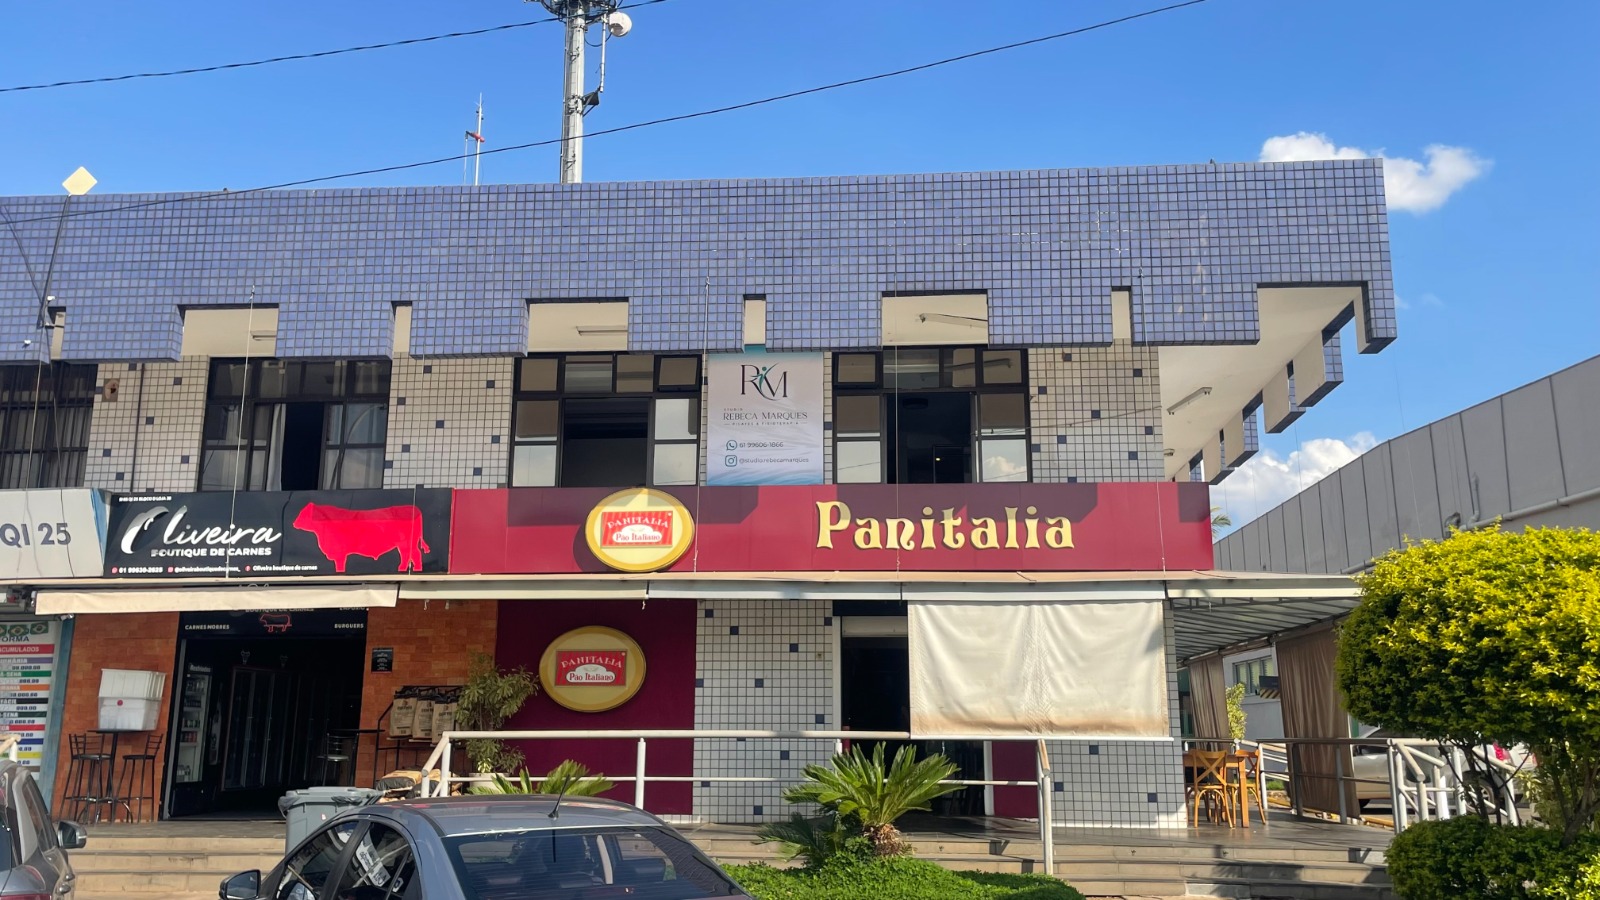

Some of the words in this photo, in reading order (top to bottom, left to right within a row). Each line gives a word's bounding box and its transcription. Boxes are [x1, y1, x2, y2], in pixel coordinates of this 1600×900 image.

[723, 412, 758, 421] REBECA
[761, 411, 808, 421] MARQUES
[607, 516, 669, 529] PANITALIA
[815, 500, 1075, 551] Panitalia
[0, 523, 31, 548] QI
[38, 522, 71, 545] 25
[631, 532, 661, 541] Italiano
[151, 548, 208, 557] BOUTIQUE
[209, 547, 225, 556] DE
[228, 547, 272, 556] CARNES
[561, 656, 622, 668] PANITALIA
[585, 672, 614, 681] Italiano
